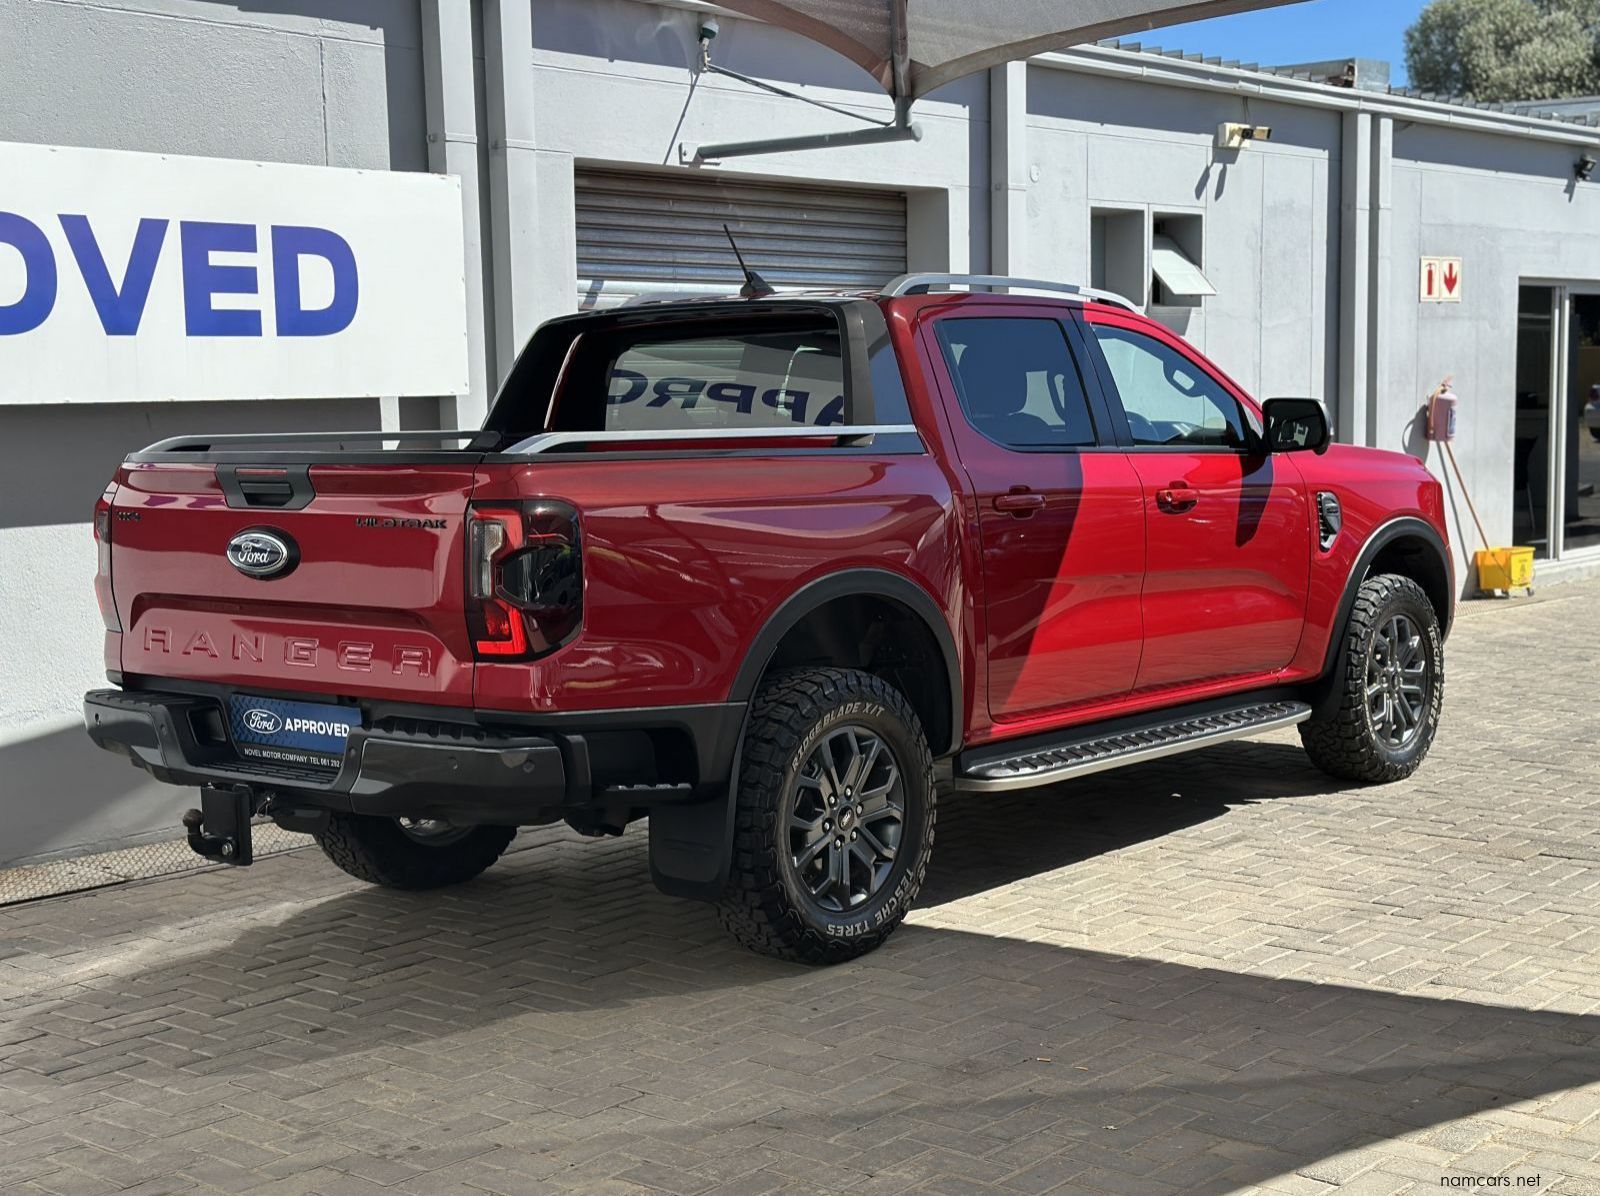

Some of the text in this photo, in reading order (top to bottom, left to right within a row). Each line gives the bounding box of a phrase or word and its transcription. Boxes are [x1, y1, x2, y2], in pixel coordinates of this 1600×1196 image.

[238, 541, 271, 563] Ford
[143, 625, 432, 678] RANGER
[250, 711, 350, 737] Ford APPROVED
[791, 702, 885, 772] RIDGE BLADE X/T
[244, 747, 262, 757] NOVEL
[262, 750, 281, 760] MOTOR
[281, 753, 308, 763] COMPANY
[309, 756, 320, 765] TEL
[826, 867, 914, 937] TESCHE TIRES
